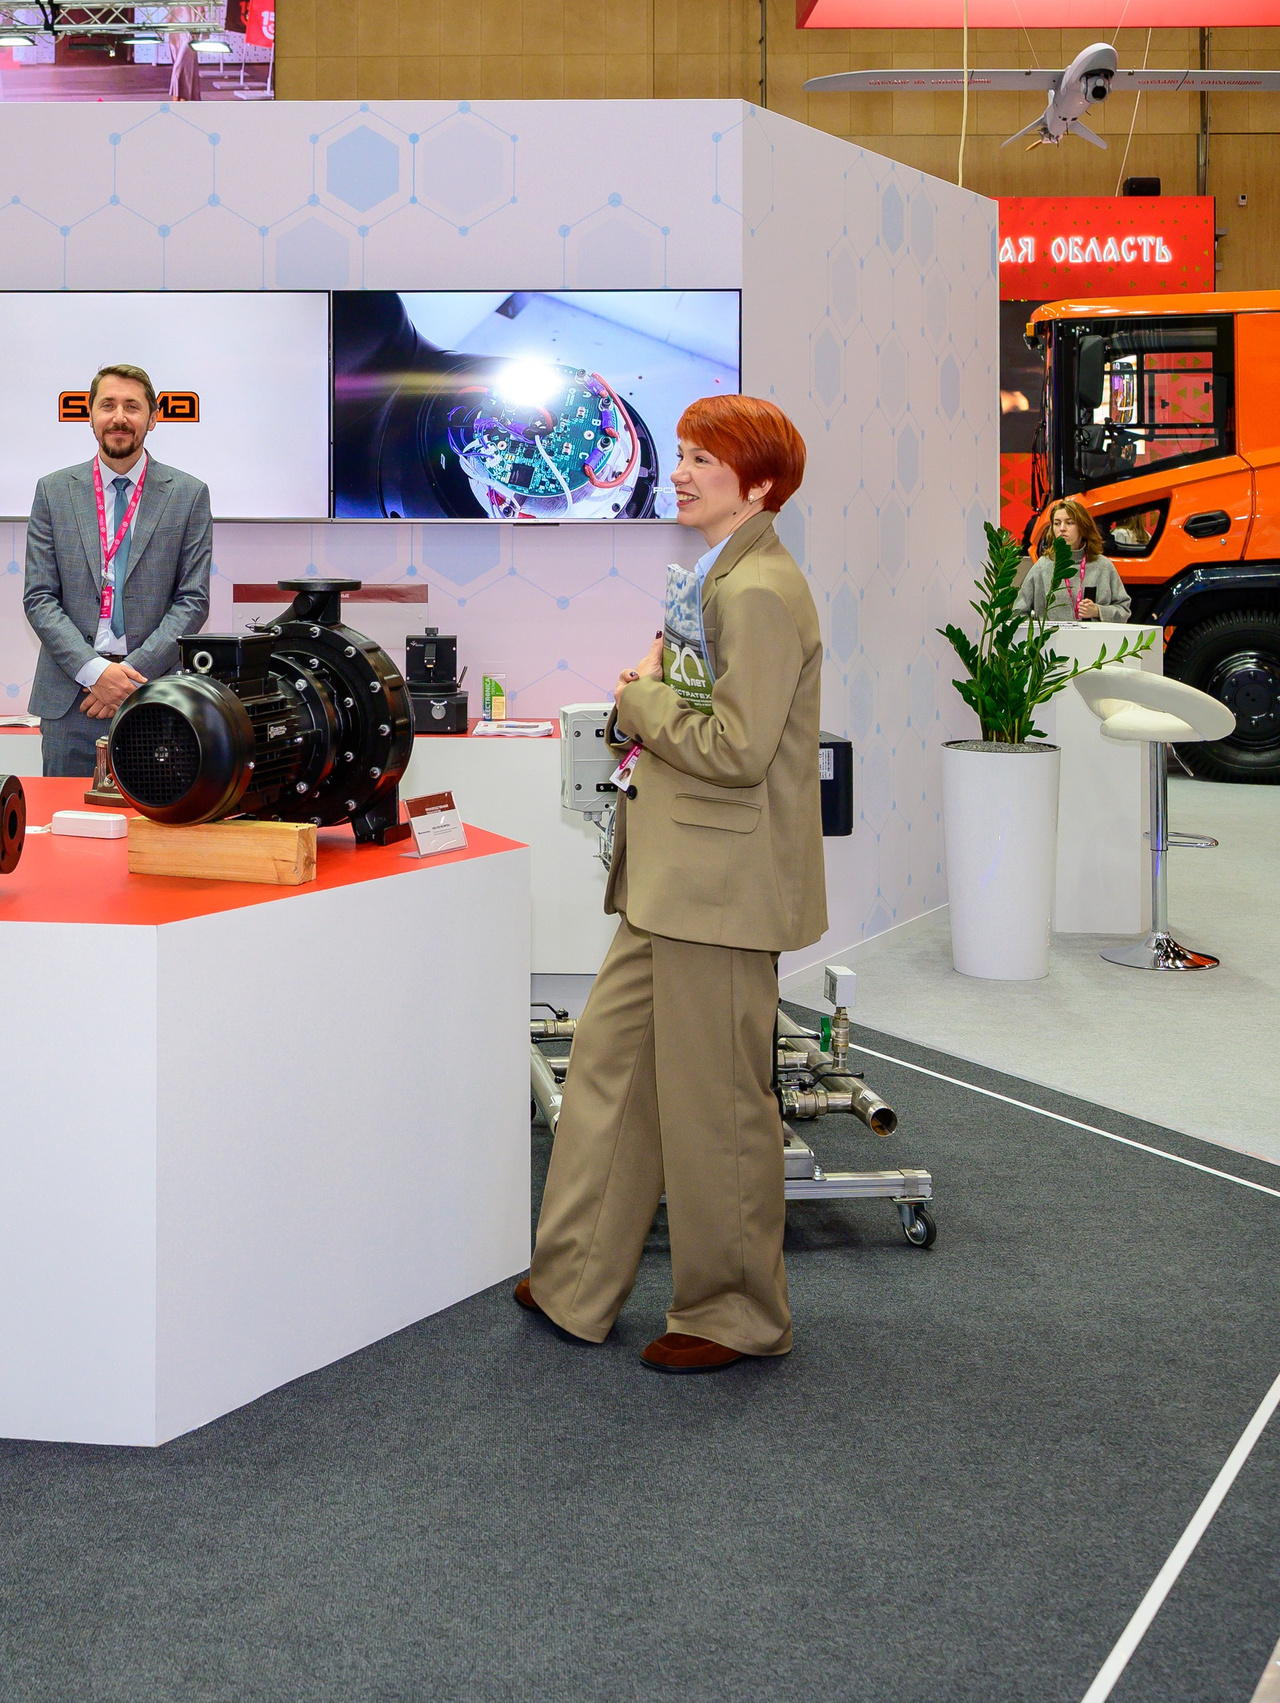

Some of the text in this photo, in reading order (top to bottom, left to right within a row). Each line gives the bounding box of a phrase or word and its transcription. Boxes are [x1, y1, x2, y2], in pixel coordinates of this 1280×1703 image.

[999, 236, 1172, 263] АЯ ОБЛАСТЬ
[670, 643, 705, 686] 20
